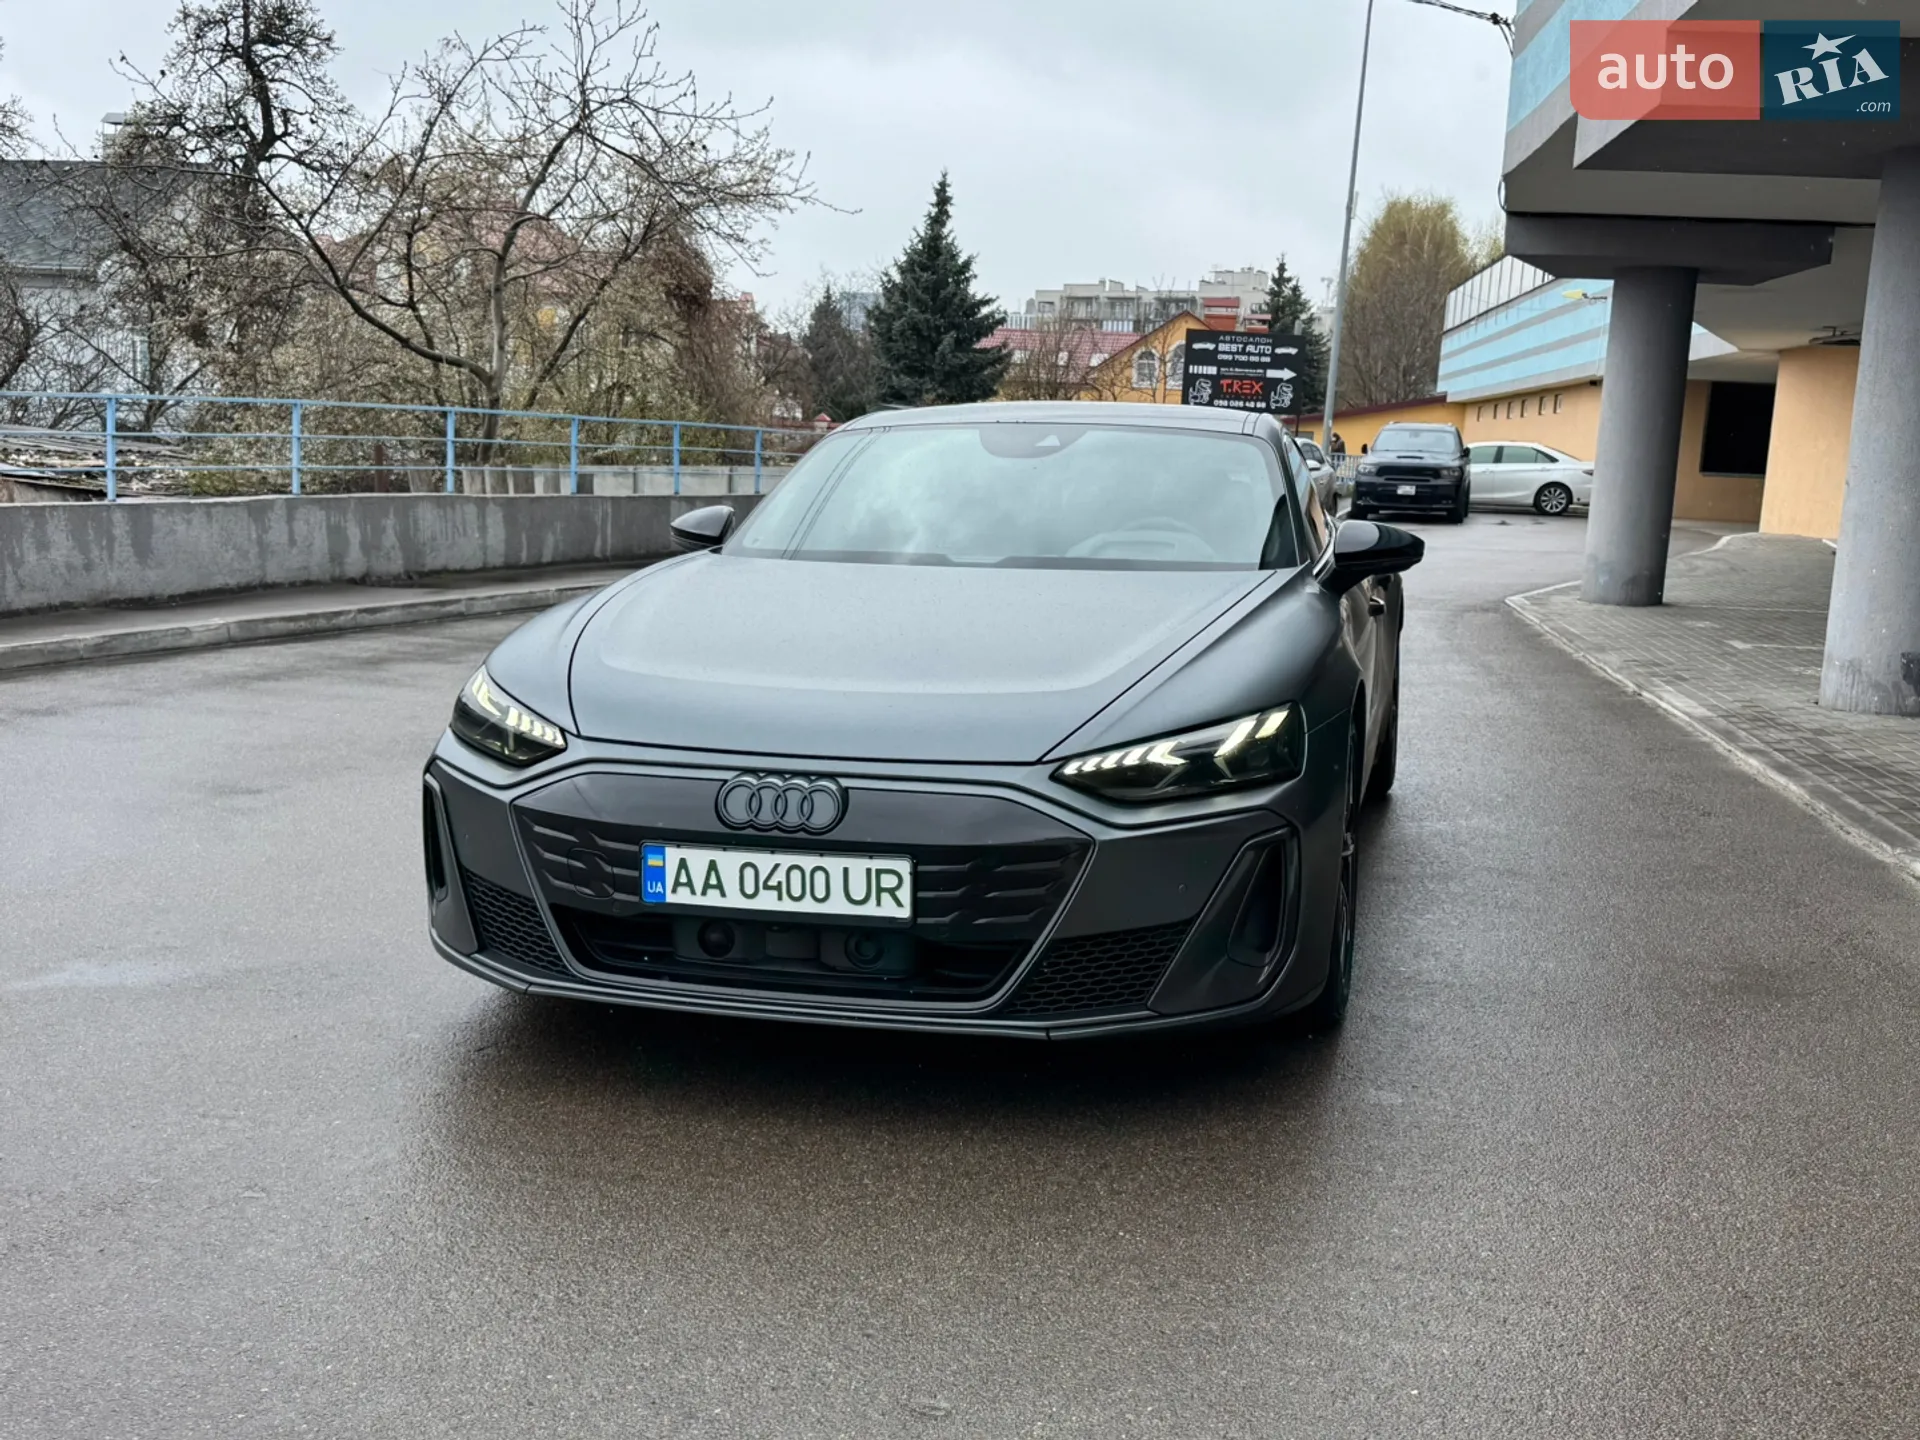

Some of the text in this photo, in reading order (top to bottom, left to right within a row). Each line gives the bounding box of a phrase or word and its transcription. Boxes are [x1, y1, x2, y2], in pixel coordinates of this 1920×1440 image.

[1218, 335, 1273, 344] АВТОСАЛОН
[1218, 342, 1272, 354] BEST AUTO
[1220, 379, 1264, 394] T.REX
[647, 881, 664, 894] UA
[671, 857, 904, 908] AA 0400 UR
